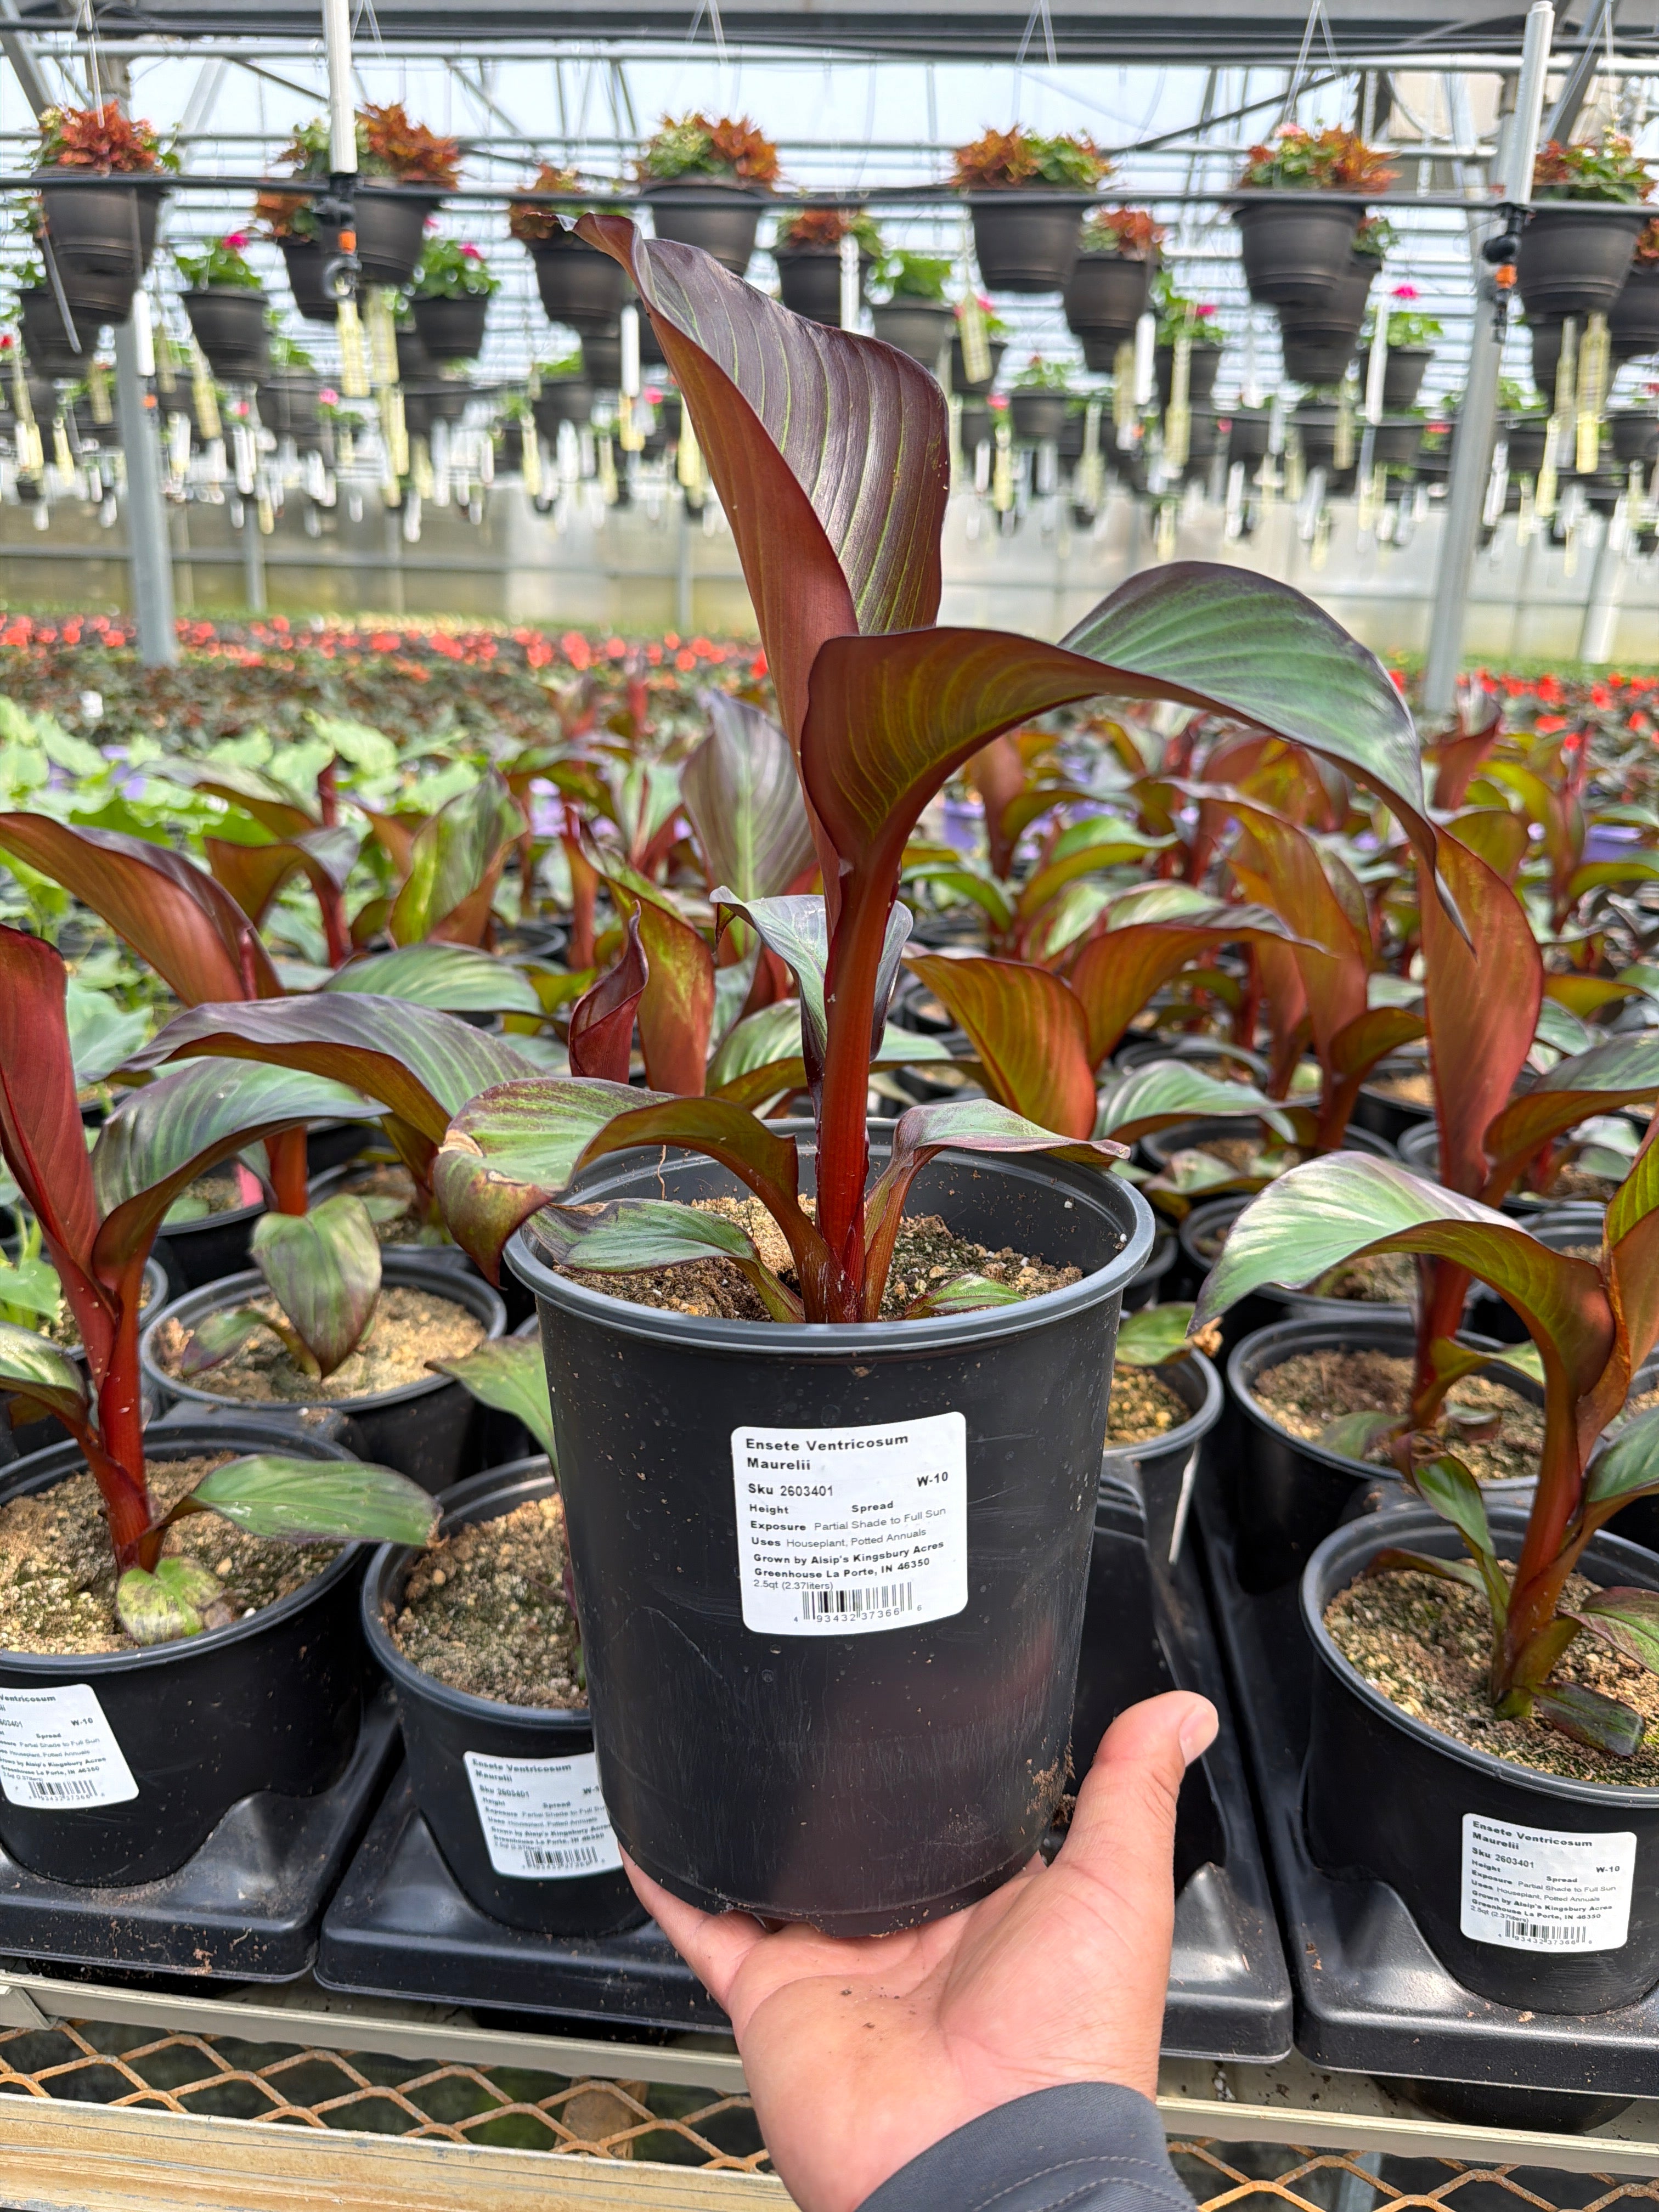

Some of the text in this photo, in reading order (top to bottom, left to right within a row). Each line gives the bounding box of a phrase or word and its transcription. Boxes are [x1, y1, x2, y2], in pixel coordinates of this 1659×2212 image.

[746, 1435, 909, 1451] Ensete Ventricosum
[747, 1458, 811, 1470] Maurelii
[917, 1472, 949, 1487] W-10
[748, 1483, 833, 1497] Sku 2603401
[749, 1504, 789, 1515] Height
[851, 1501, 894, 1514] Spread
[751, 1521, 806, 1532] Exposure
[814, 1521, 848, 1530] Partial
[851, 1519, 887, 1529] Shade
[904, 1513, 922, 1522] Full
[925, 1508, 946, 1519] Sun
[751, 1528, 926, 1548] Uses Houseplant, Potted Annuals
[754, 1541, 944, 1565] Grown by Alsip's Kingsbury Acres
[754, 1568, 822, 1578] Greenhouse
[844, 1568, 877, 1578] Porte,
[898, 1558, 930, 1570] 46350
[754, 1580, 833, 1590] 2.5qt (2.37liters)
[71, 1717, 93, 1726] W-10
[1472, 1832, 1519, 1850] Maurelii
[1473, 1820, 1592, 1847] Ensete Ventricosum
[1472, 1847, 1534, 1868] Sku 2603401
[1471, 1859, 1500, 1872] Height
[1471, 1869, 1513, 1884] Exposure
[1518, 1881, 1543, 1889] Partial
[1471, 1879, 1493, 1890] Uses
[1472, 1890, 1499, 1901] Grown
[1471, 1899, 1521, 1915] Greenhouse
